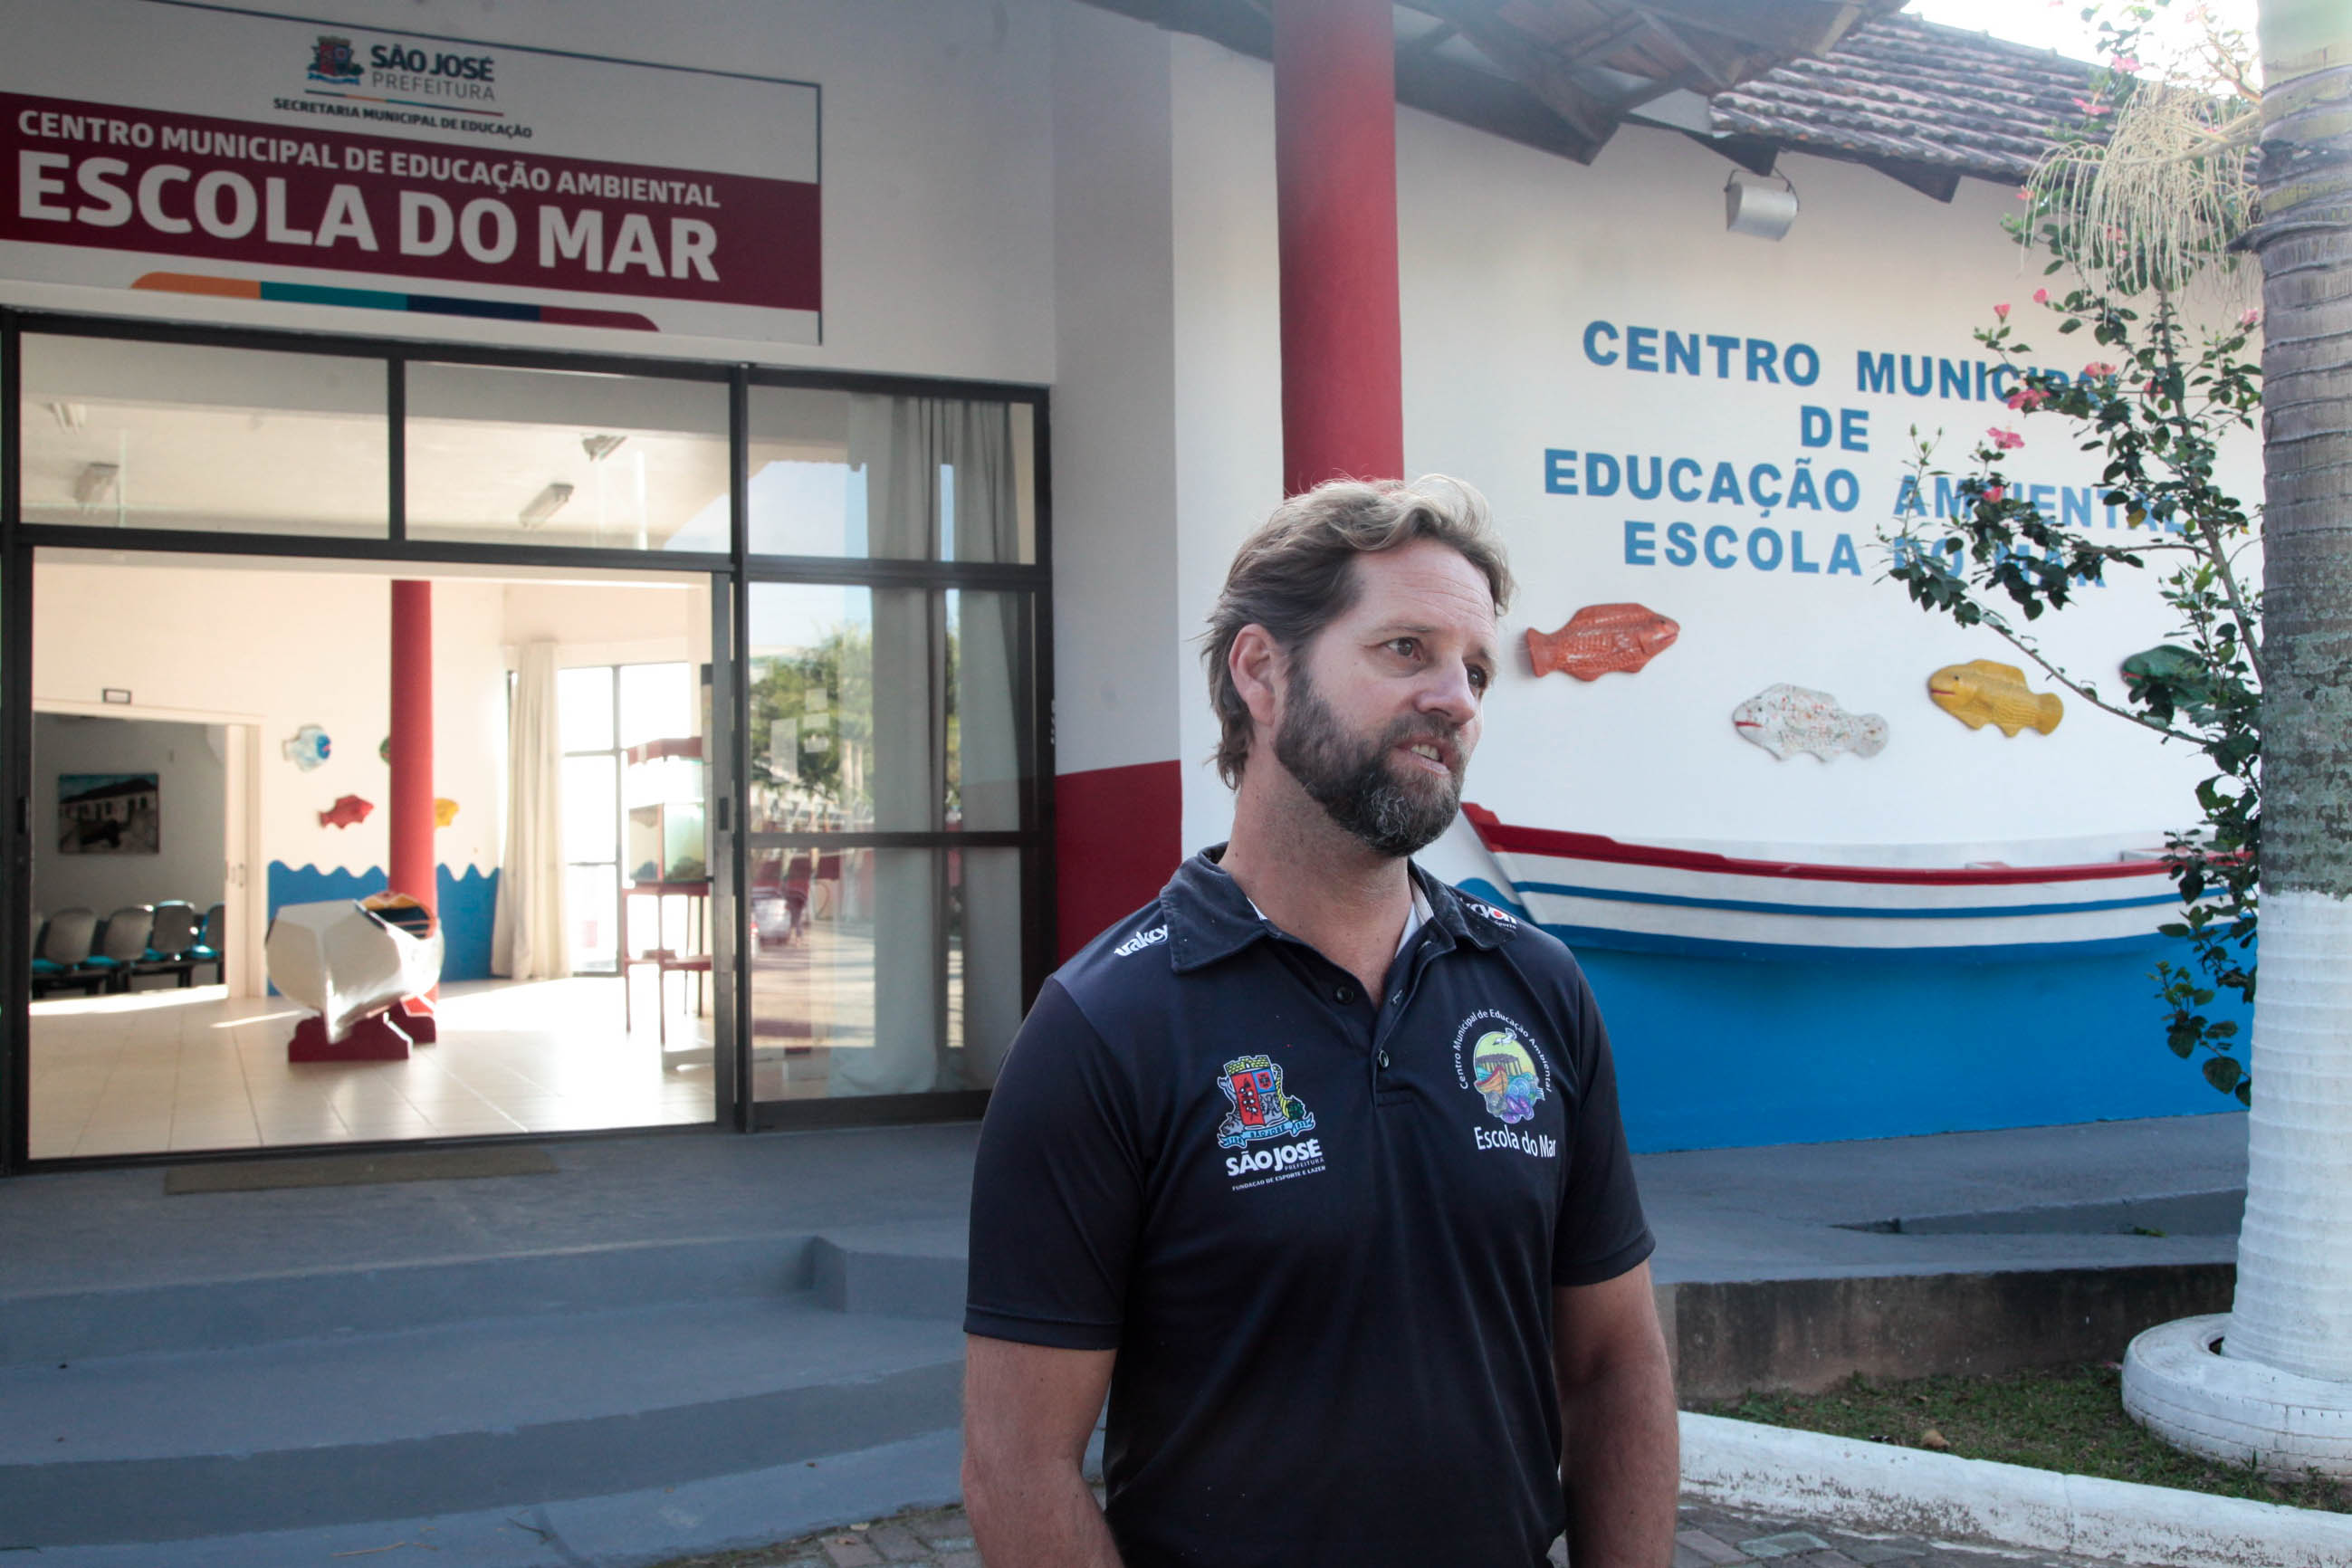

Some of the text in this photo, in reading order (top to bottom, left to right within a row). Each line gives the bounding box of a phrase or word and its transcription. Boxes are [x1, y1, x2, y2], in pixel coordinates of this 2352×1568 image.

[370, 44, 495, 82] SÃO JOSÉ
[372, 72, 495, 100] PREFEITURA
[273, 98, 532, 139] SECRETARIA MUNICIPAL DE EDUCAÇÃO
[18, 110, 721, 208] CENTRO MUNICIPAL DE EDUCAÇÃO AMBIENTAL
[19, 149, 721, 282] ESCOLA DO MAR
[1583, 320, 2124, 412] CENTRO MUNICP
[1801, 405, 1869, 453] DE
[1544, 448, 2188, 535] EDUCAÇÃO AMIENTAL
[1624, 520, 1862, 576] ESCOLA
[1453, 1009, 1552, 1093] Centro Municipal de Educação Ambiental
[1226, 1138, 1323, 1176] SÃO JOSÉ
[1474, 1124, 1556, 1158] Escola do Mar
[1275, 1171, 1301, 1181] ESPORTE
[1285, 1158, 1324, 1171] PREFEITURA
